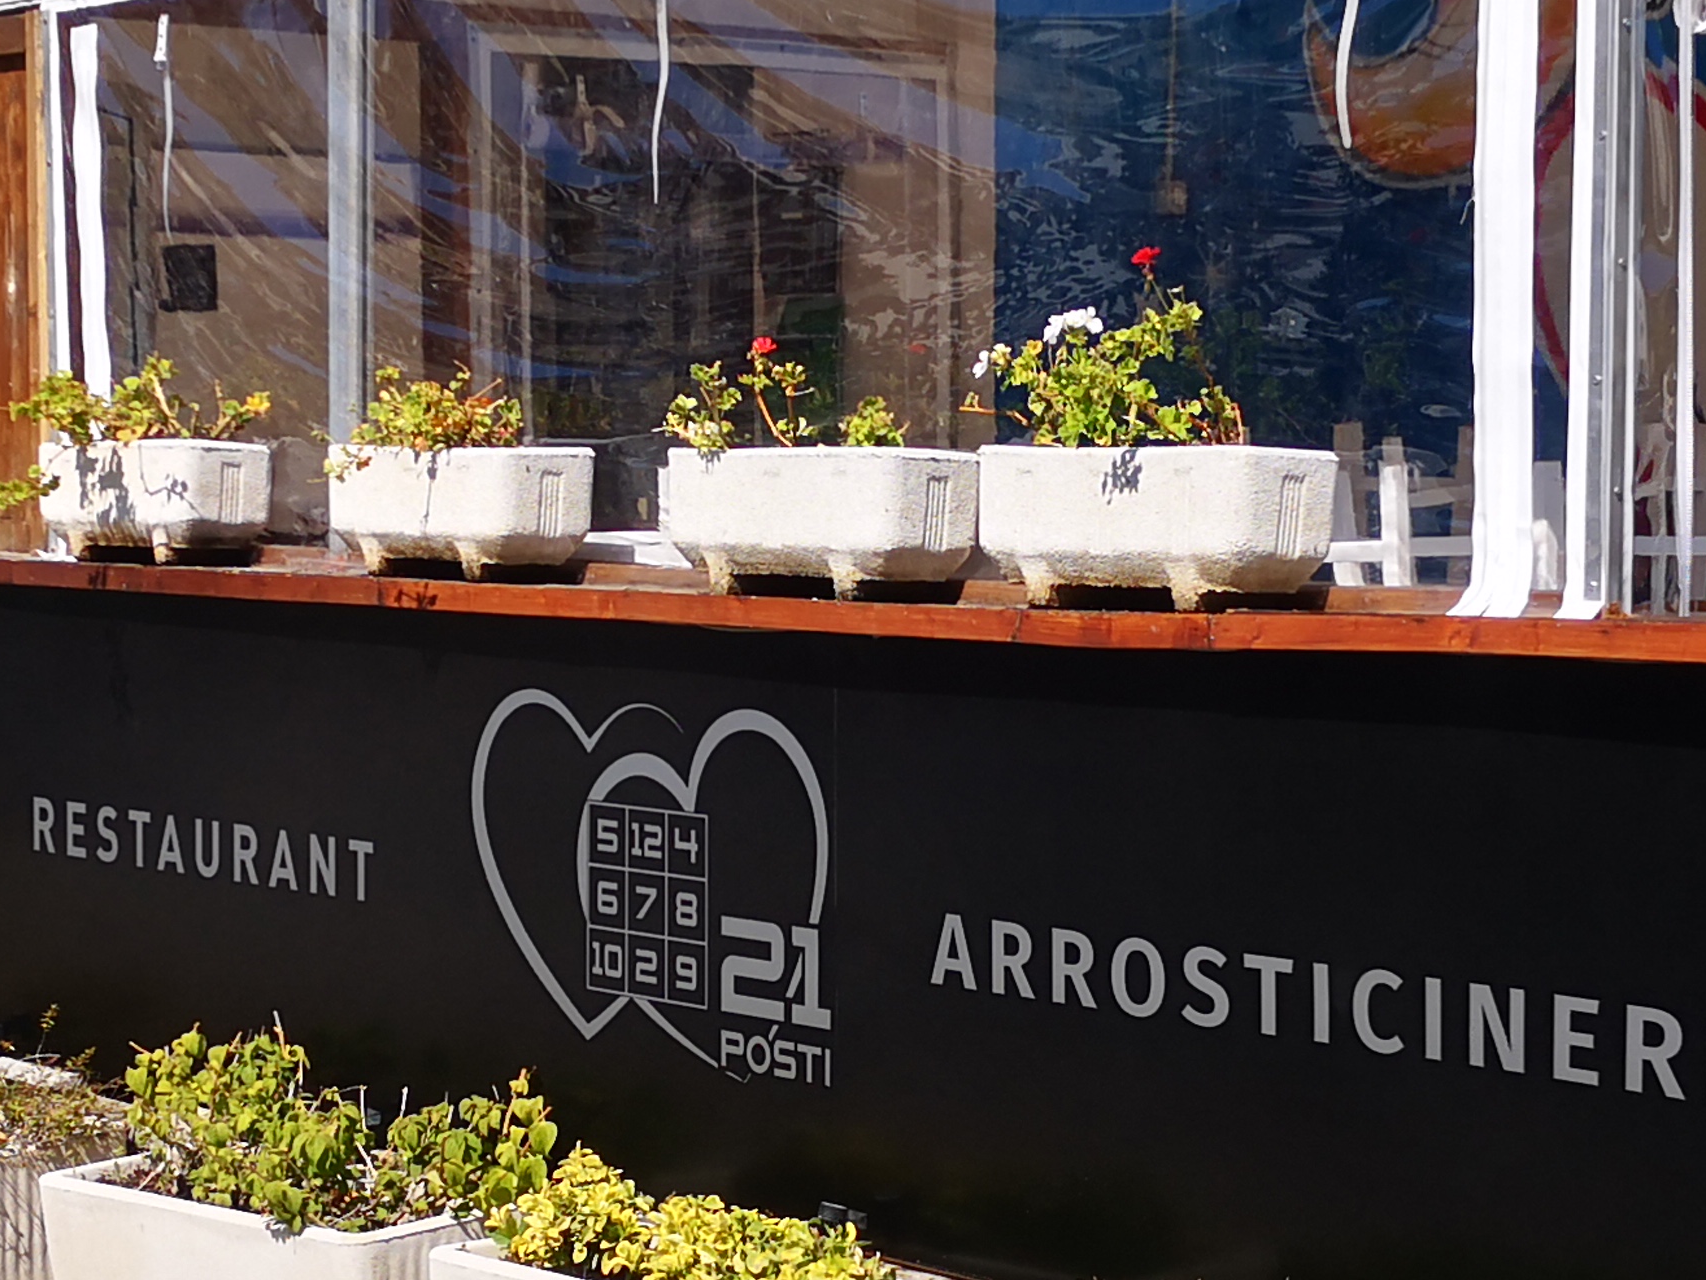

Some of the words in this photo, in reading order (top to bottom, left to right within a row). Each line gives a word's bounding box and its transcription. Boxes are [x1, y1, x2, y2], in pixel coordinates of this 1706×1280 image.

[31, 794, 376, 903] RESTAURANT
[596, 819, 619, 853] 5
[631, 822, 663, 859] 12
[674, 827, 698, 864] 4
[597, 881, 618, 915] 6
[635, 886, 658, 919] 7
[675, 892, 698, 927] 8
[591, 941, 623, 979] 10
[636, 949, 658, 984] 2
[675, 956, 698, 990] 9
[720, 915, 832, 1030] 21
[720, 1029, 832, 1088] POSTI
